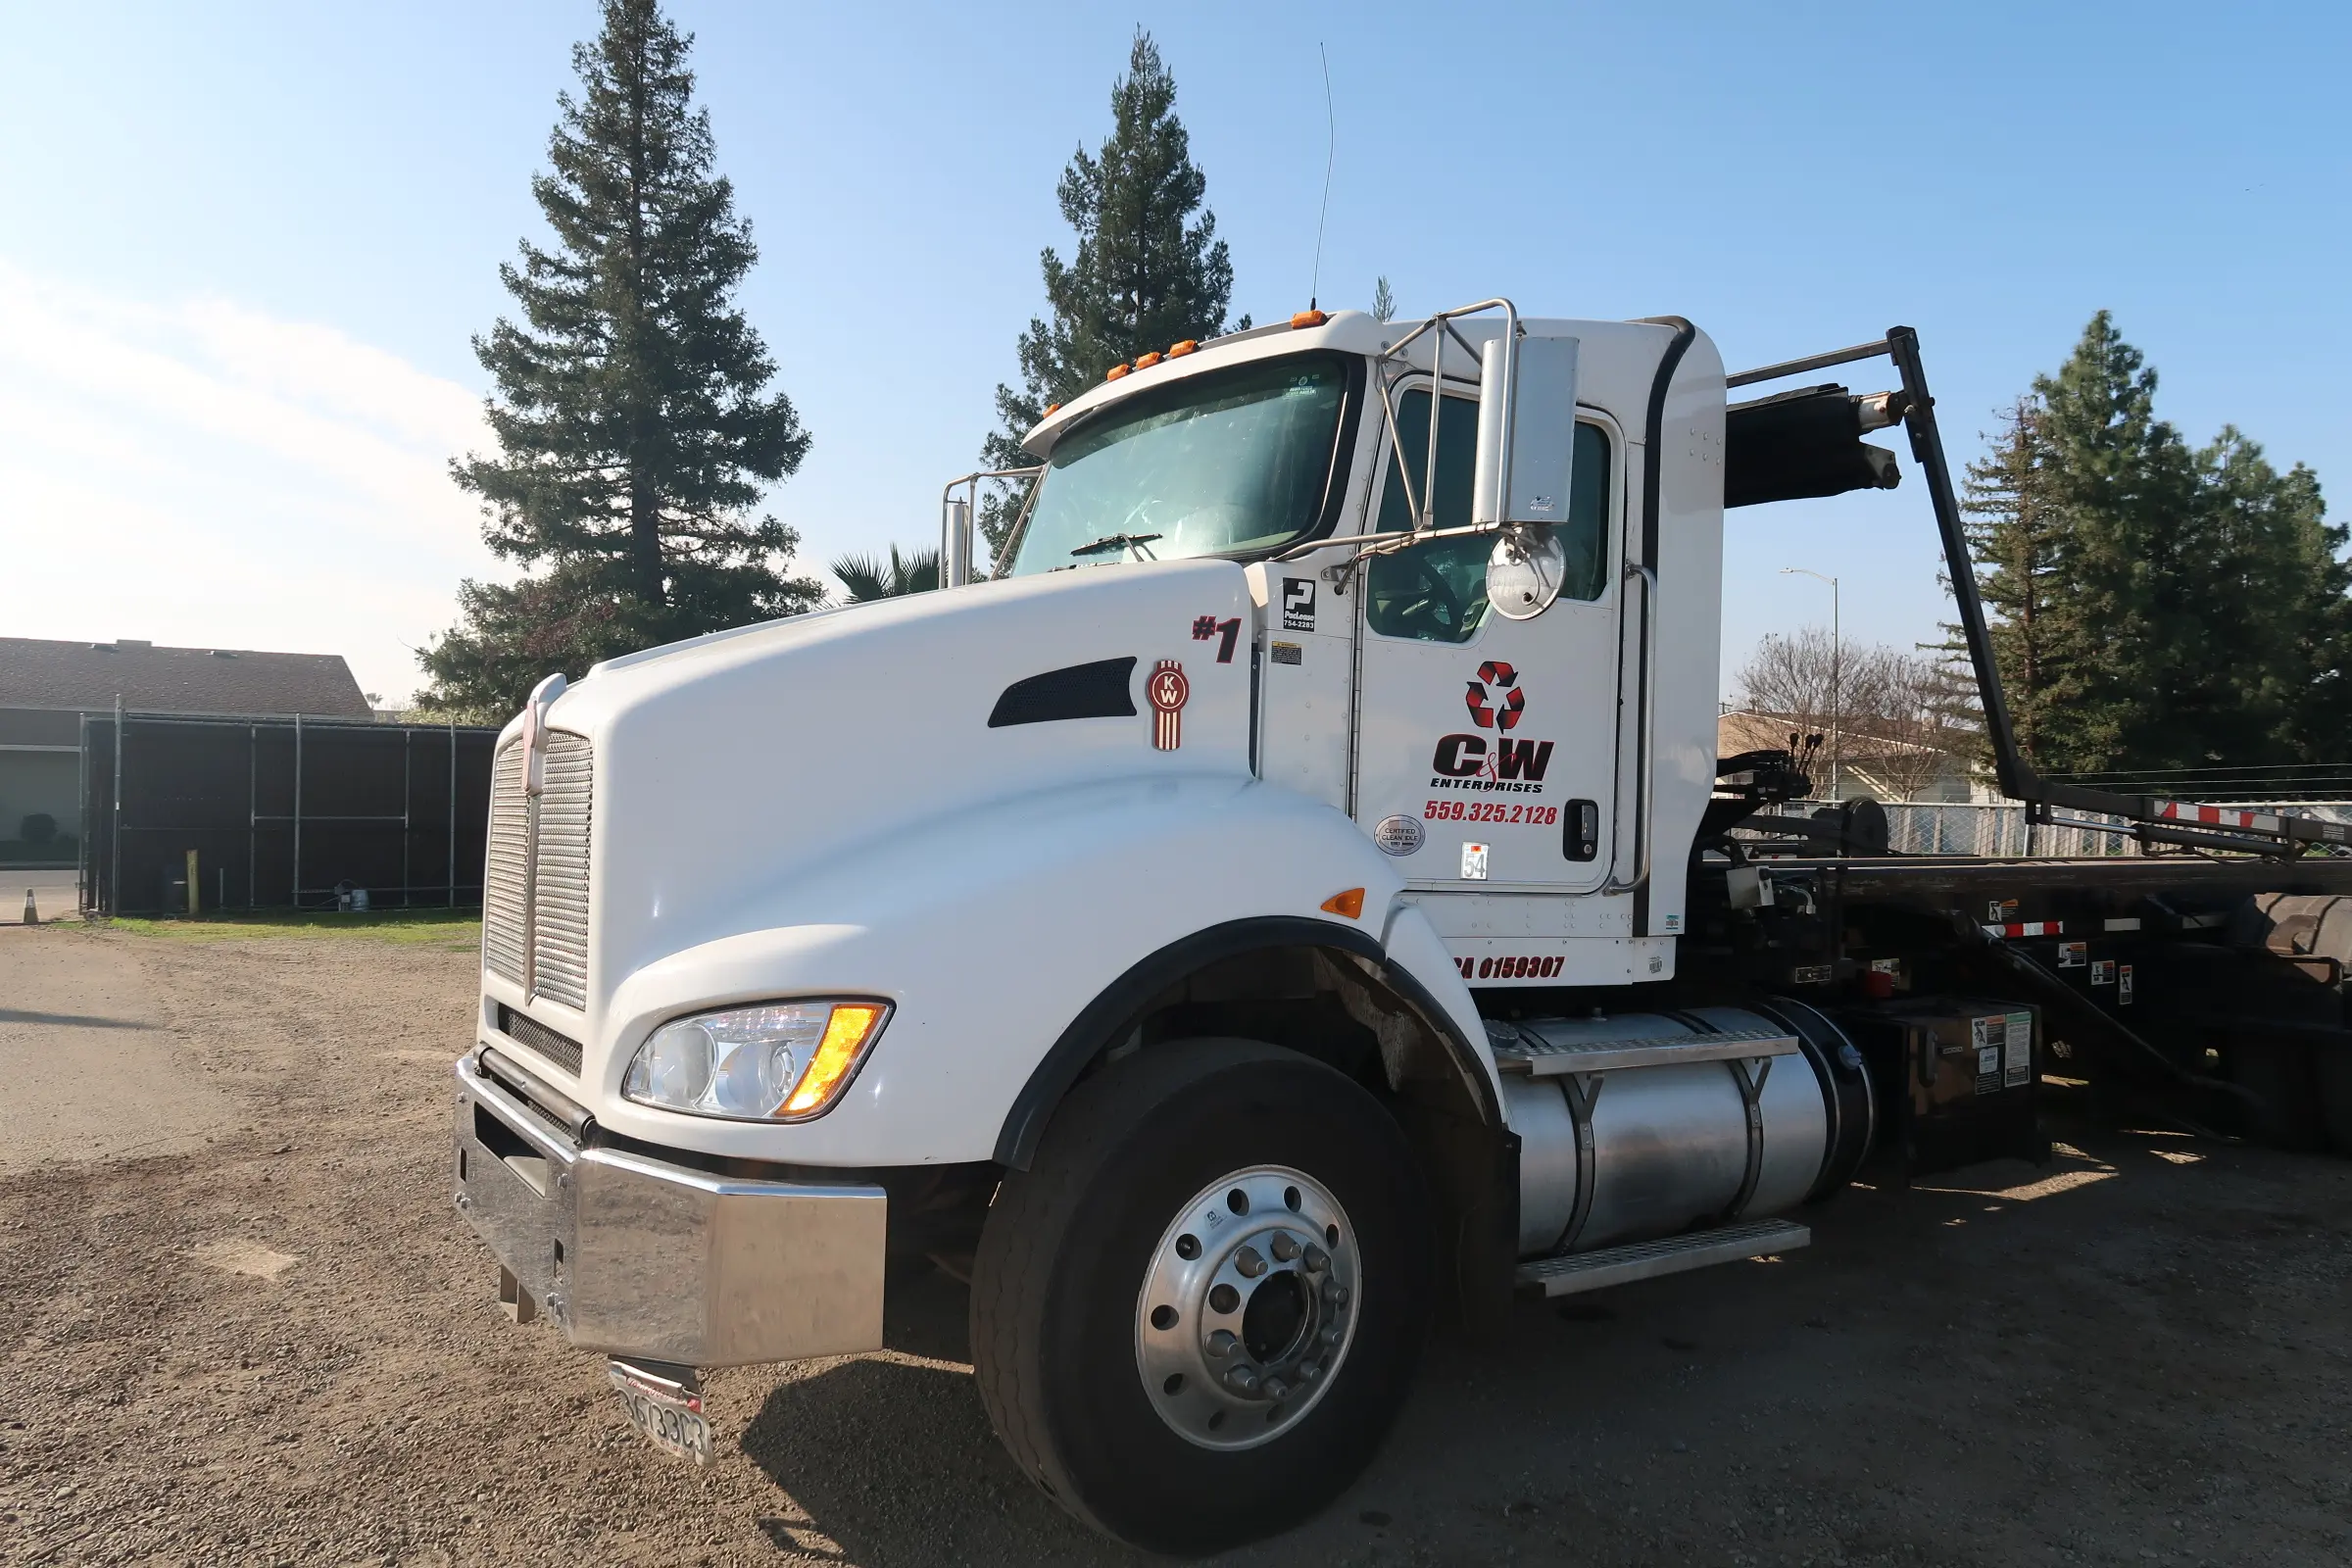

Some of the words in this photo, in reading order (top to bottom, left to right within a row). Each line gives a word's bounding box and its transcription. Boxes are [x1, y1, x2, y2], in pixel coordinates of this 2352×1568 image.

[1284, 611, 1315, 621] PacLease
[1284, 619, 1314, 629] 754-2283
[1192, 615, 1243, 664] #1
[1430, 777, 1544, 794] ENTERPRISES
[1424, 800, 1558, 825] 559.325.2128
[1463, 853, 1486, 878] 54
[1478, 956, 1565, 979] 0159307
